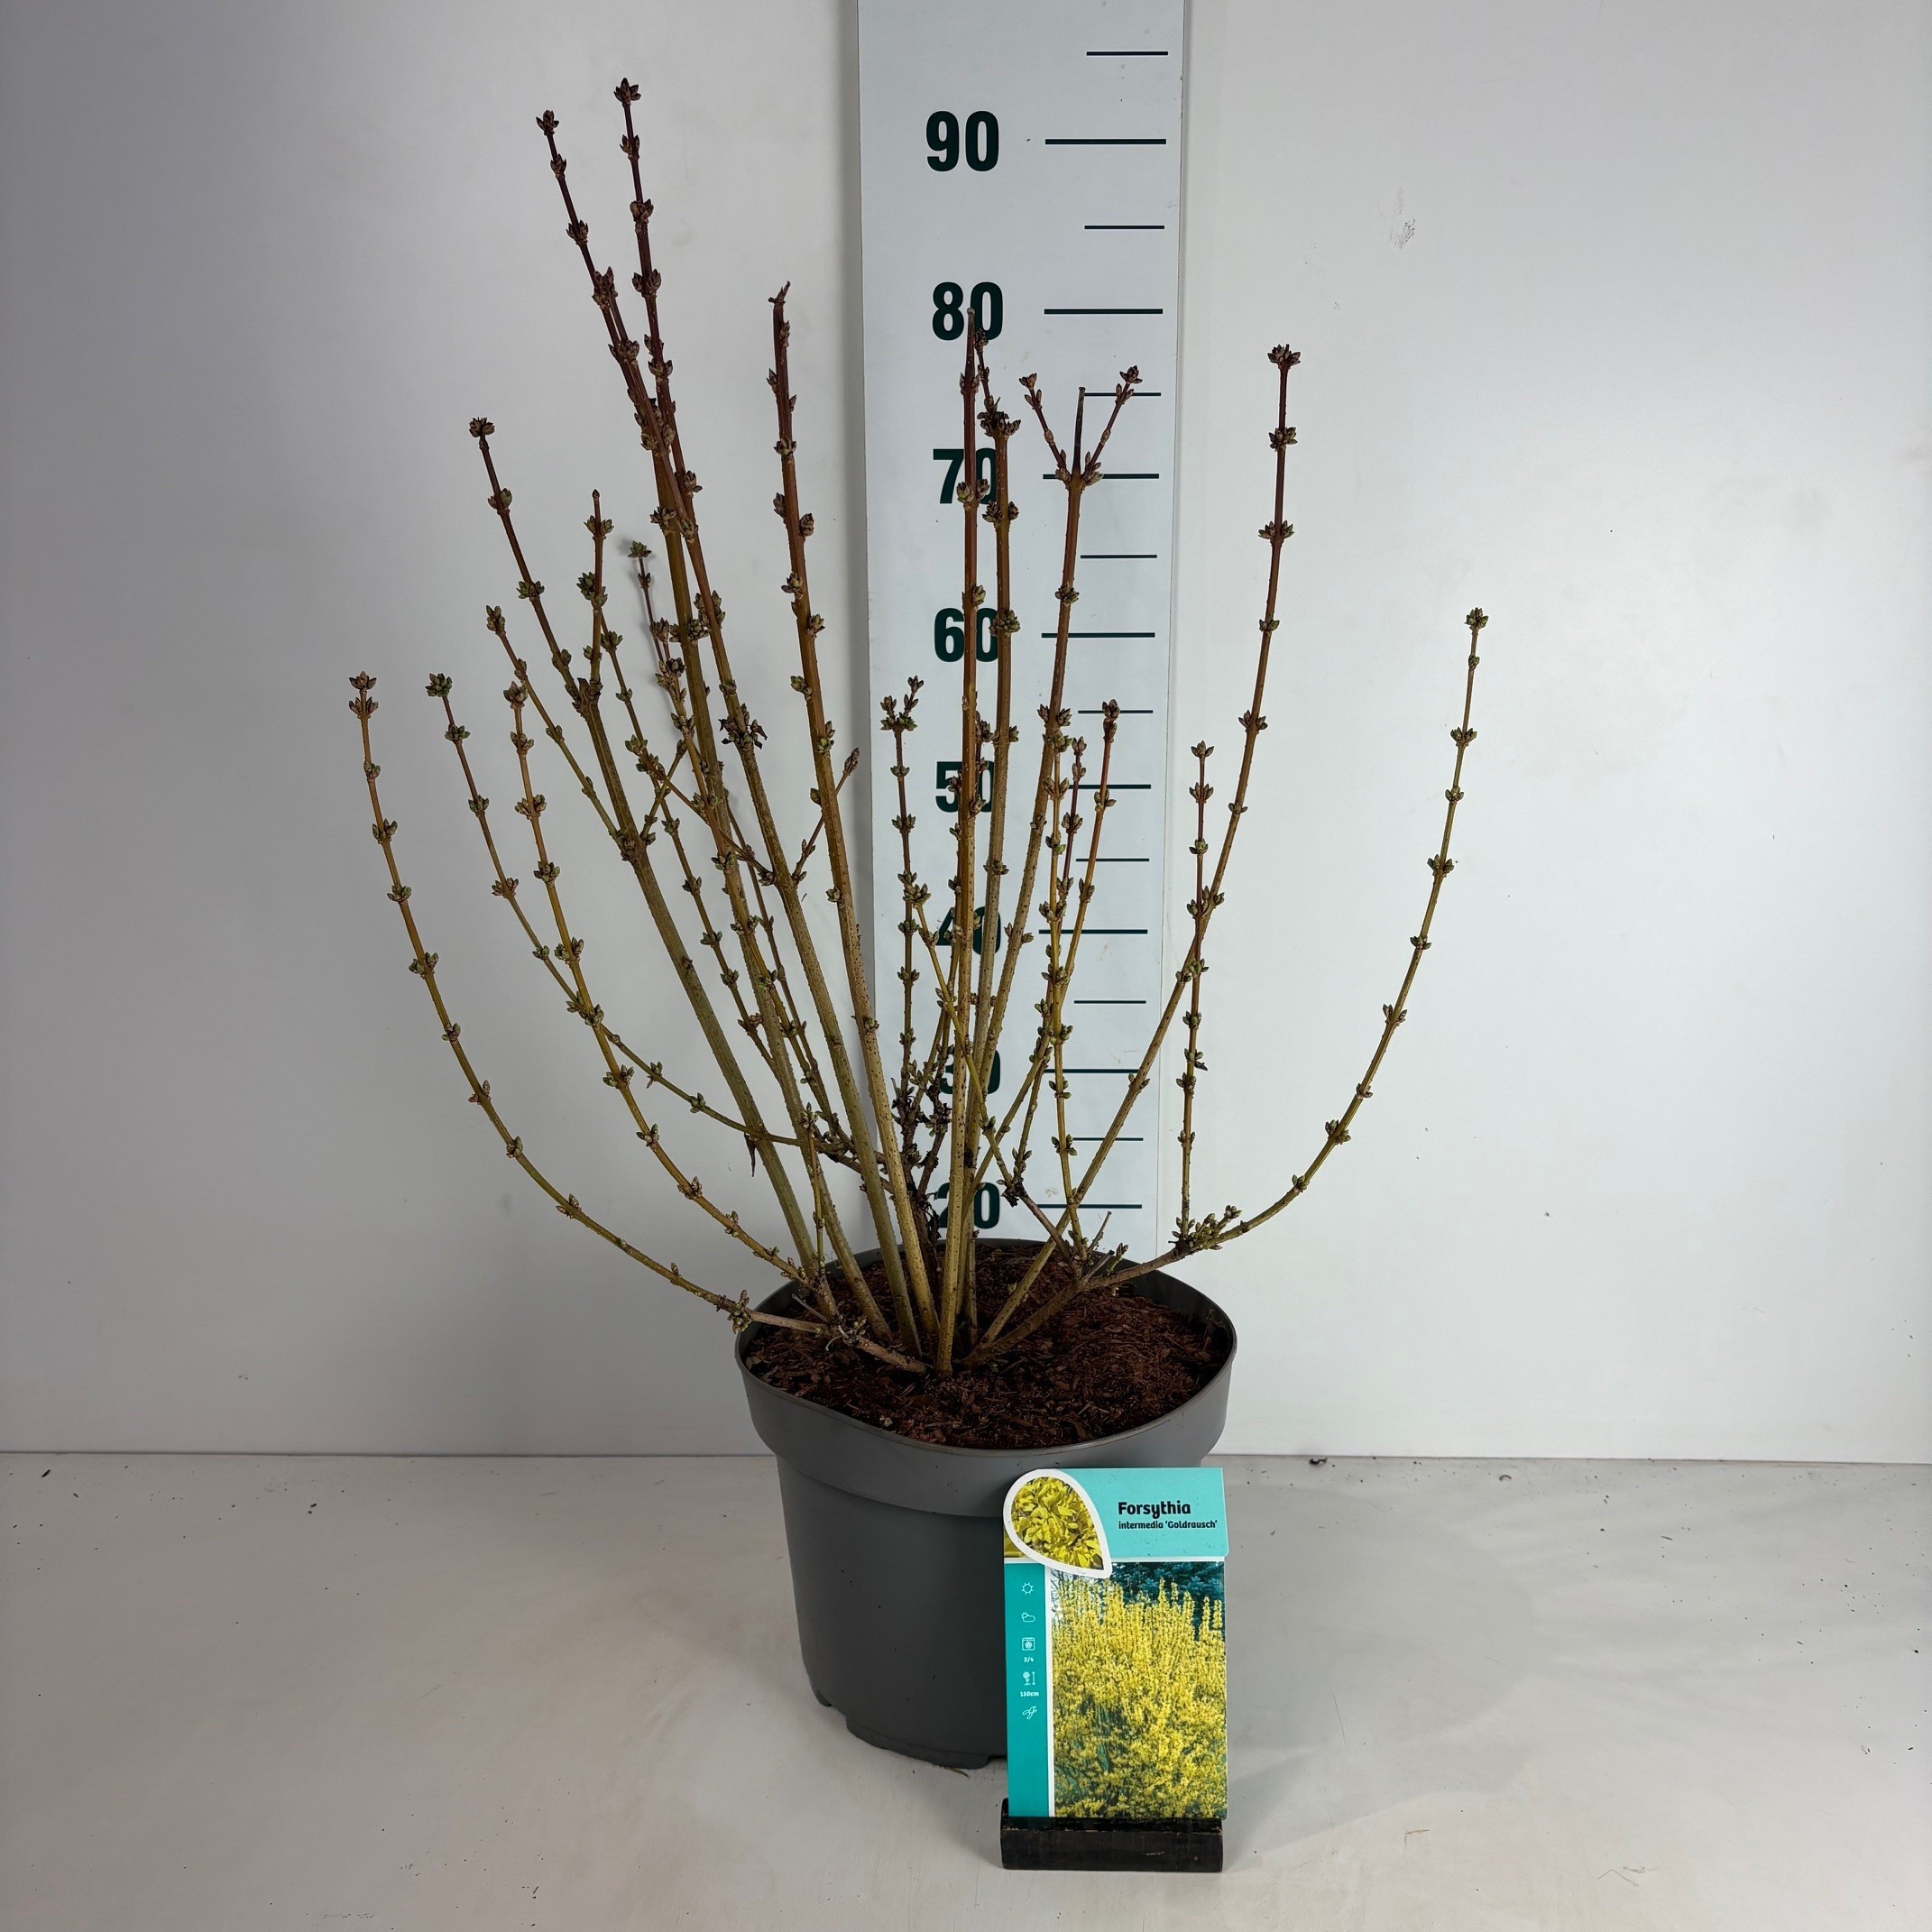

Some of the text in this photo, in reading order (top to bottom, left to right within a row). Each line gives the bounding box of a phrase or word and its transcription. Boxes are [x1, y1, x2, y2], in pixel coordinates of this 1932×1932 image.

[925, 110, 999, 172] 90
[932, 281, 1004, 341] 80
[933, 447, 998, 505] 70
[934, 607, 999, 663] 60
[935, 760, 997, 814] 50
[1118, 1500, 1191, 1520] Forsythia
[1118, 1520, 1218, 1530] intermedia 'Goldrausch'
